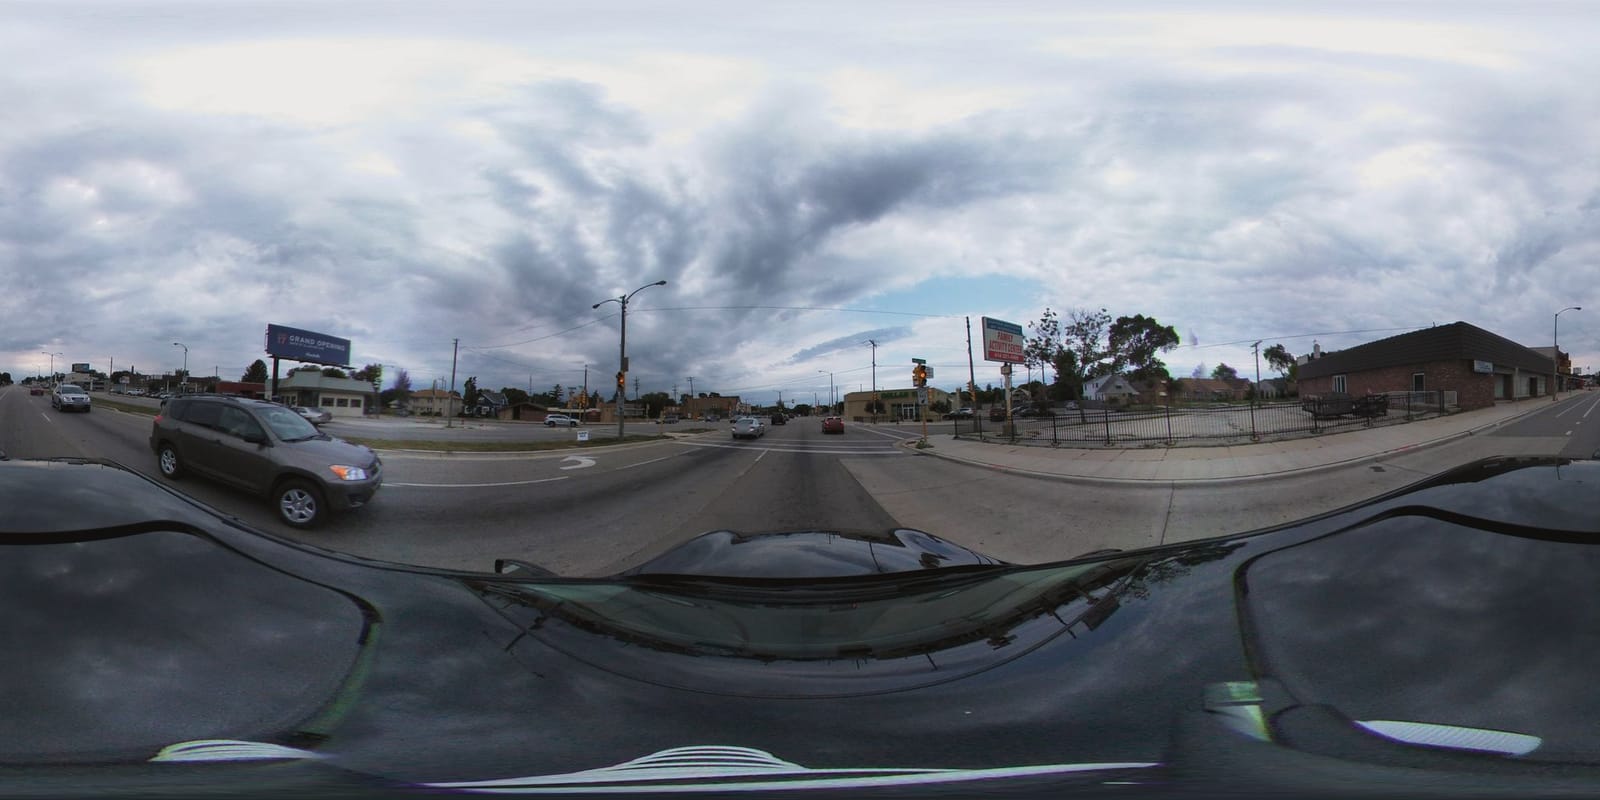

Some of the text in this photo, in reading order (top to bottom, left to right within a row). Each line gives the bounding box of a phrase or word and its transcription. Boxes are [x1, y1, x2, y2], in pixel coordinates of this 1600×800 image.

[289, 335, 315, 345] GRAND
[317, 341, 345, 351] OPENING
[997, 331, 1013, 343] FAMILY
[989, 339, 1008, 352] ACTIVITY
